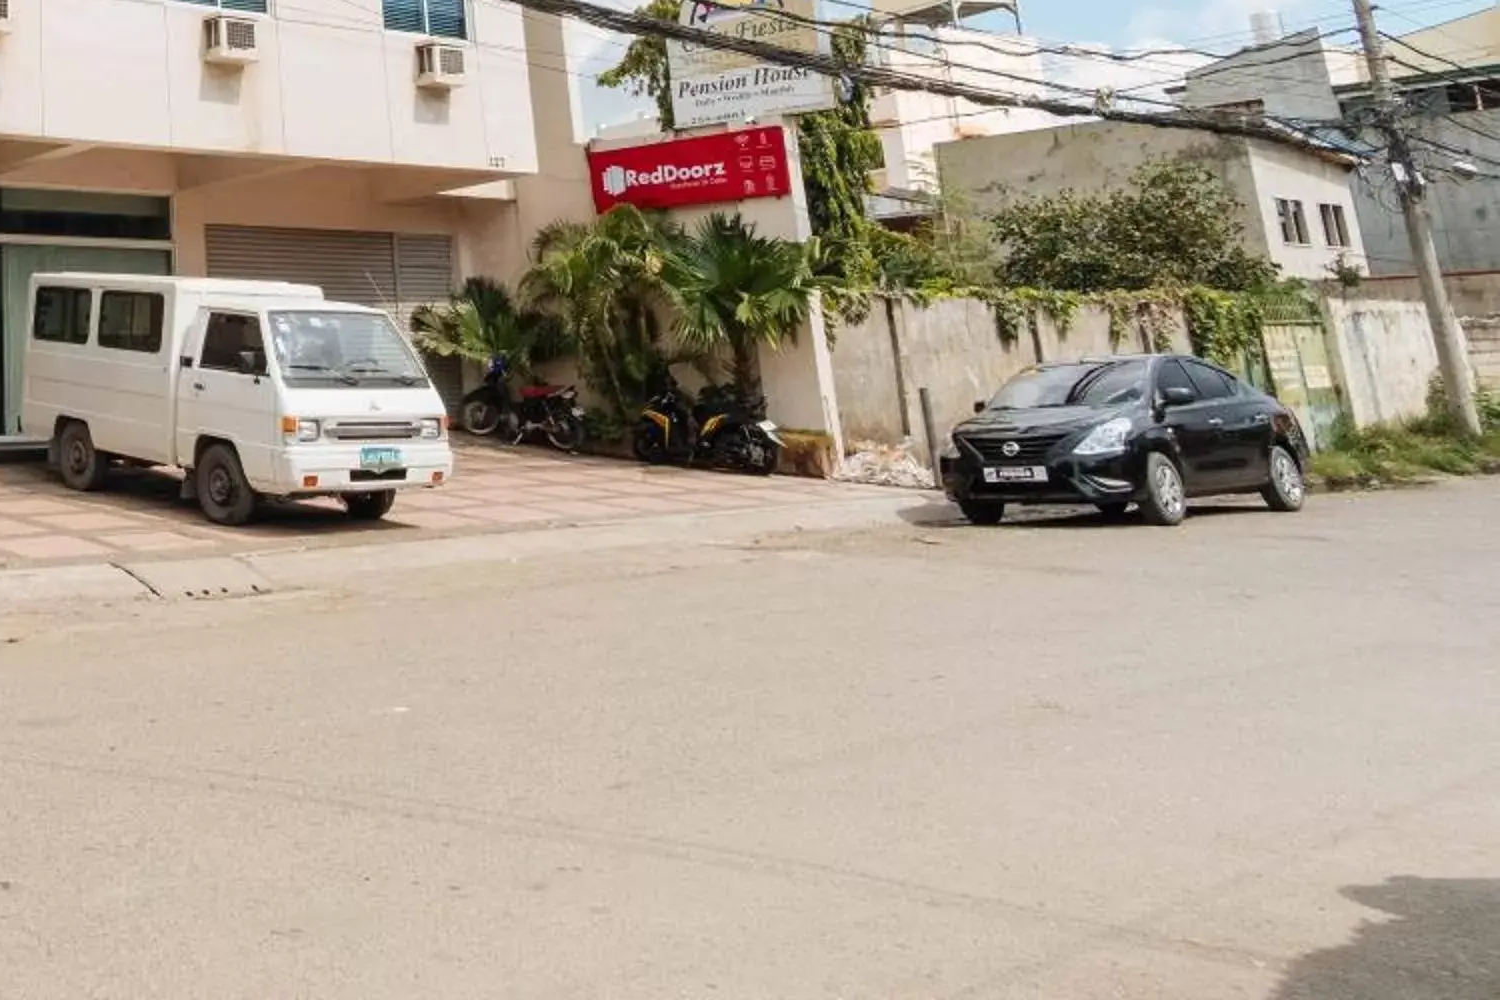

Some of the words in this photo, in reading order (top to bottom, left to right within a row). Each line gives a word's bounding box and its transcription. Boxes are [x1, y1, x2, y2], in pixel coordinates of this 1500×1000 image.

[678, 75, 747, 98] Pension
[754, 65, 810, 86] House
[626, 160, 728, 187] RedDoorz
